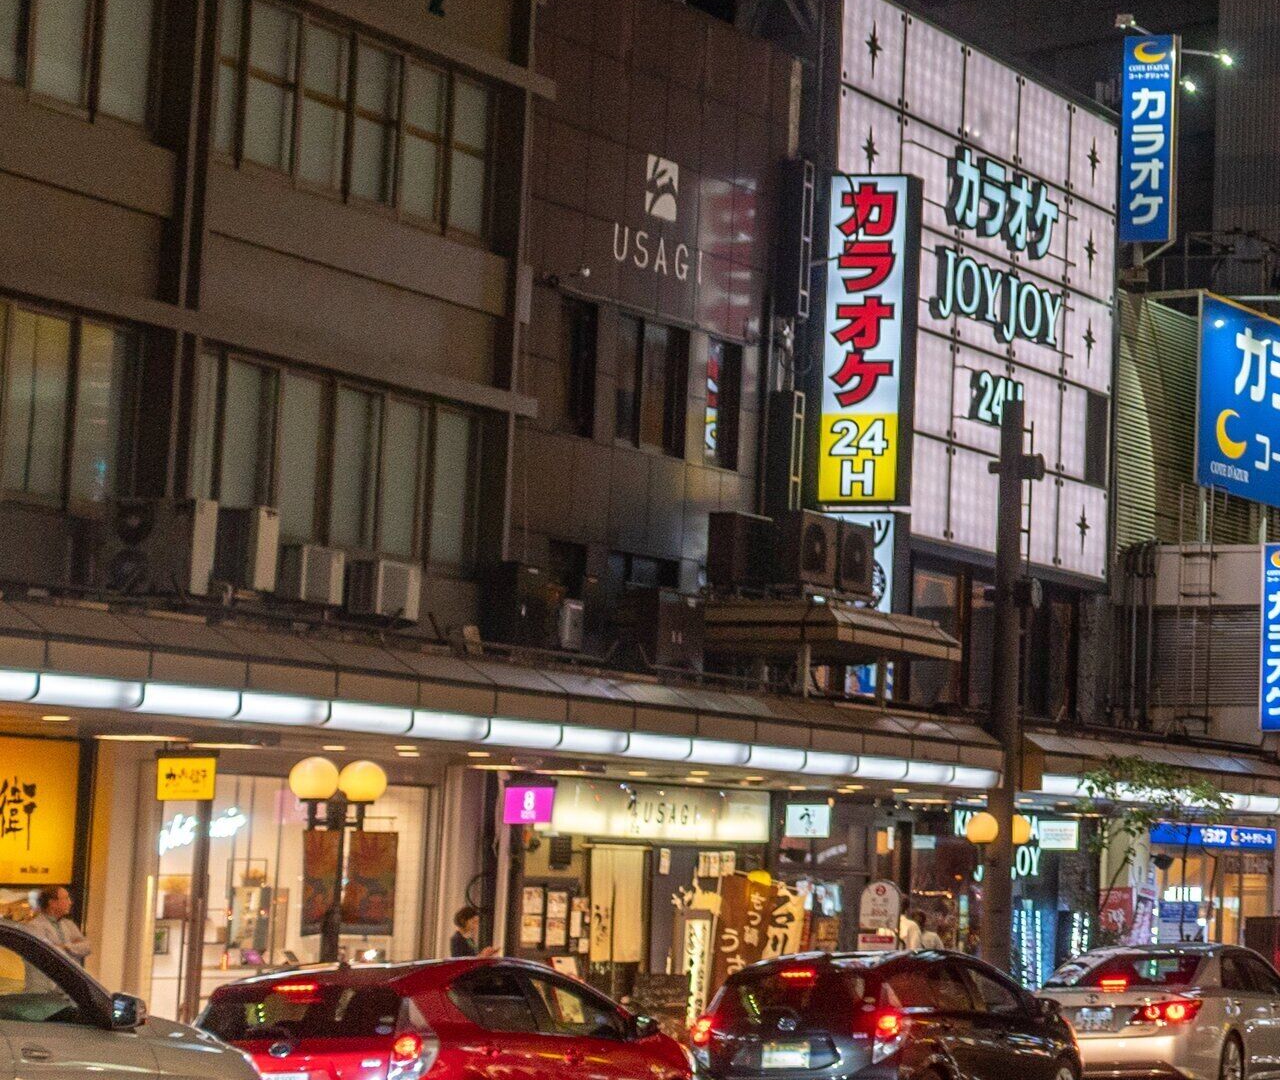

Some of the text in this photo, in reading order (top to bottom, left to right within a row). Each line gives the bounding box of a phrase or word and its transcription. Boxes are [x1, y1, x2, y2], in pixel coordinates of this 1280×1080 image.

[1130, 88, 1166, 225] カラオケ
[954, 148, 1060, 260] カラオケ
[612, 223, 704, 285] USAGI
[833, 182, 899, 409] カラオケ
[829, 419, 888, 458] 24
[839, 460, 875, 498] H
[523, 790, 536, 811] 8
[643, 801, 698, 824] USAGI
